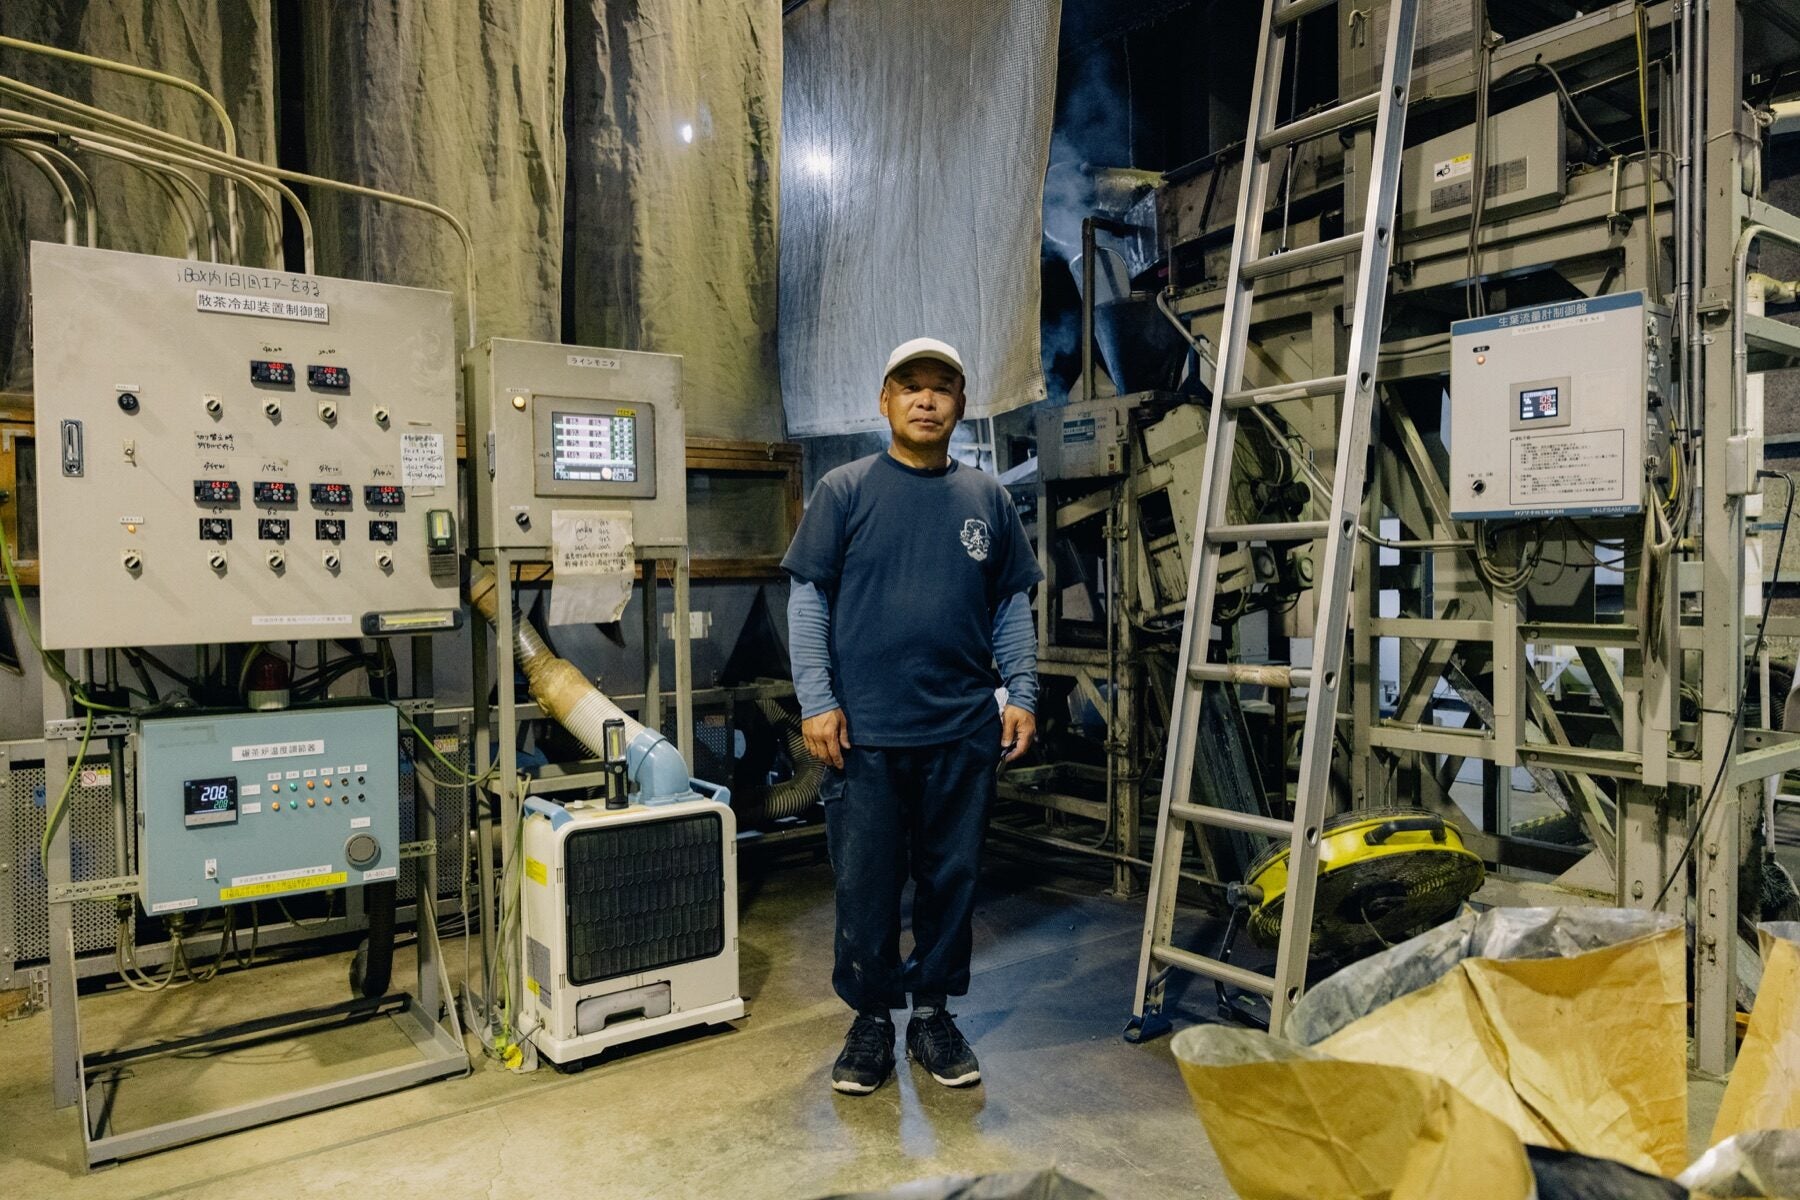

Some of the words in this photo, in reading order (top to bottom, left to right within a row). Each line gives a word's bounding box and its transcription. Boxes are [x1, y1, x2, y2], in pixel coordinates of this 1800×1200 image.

[198, 293, 326, 319] 散茶冷却装置制御盤
[1498, 302, 1588, 328] 生葉流量計制御盤
[571, 357, 616, 367] ラインモニタ
